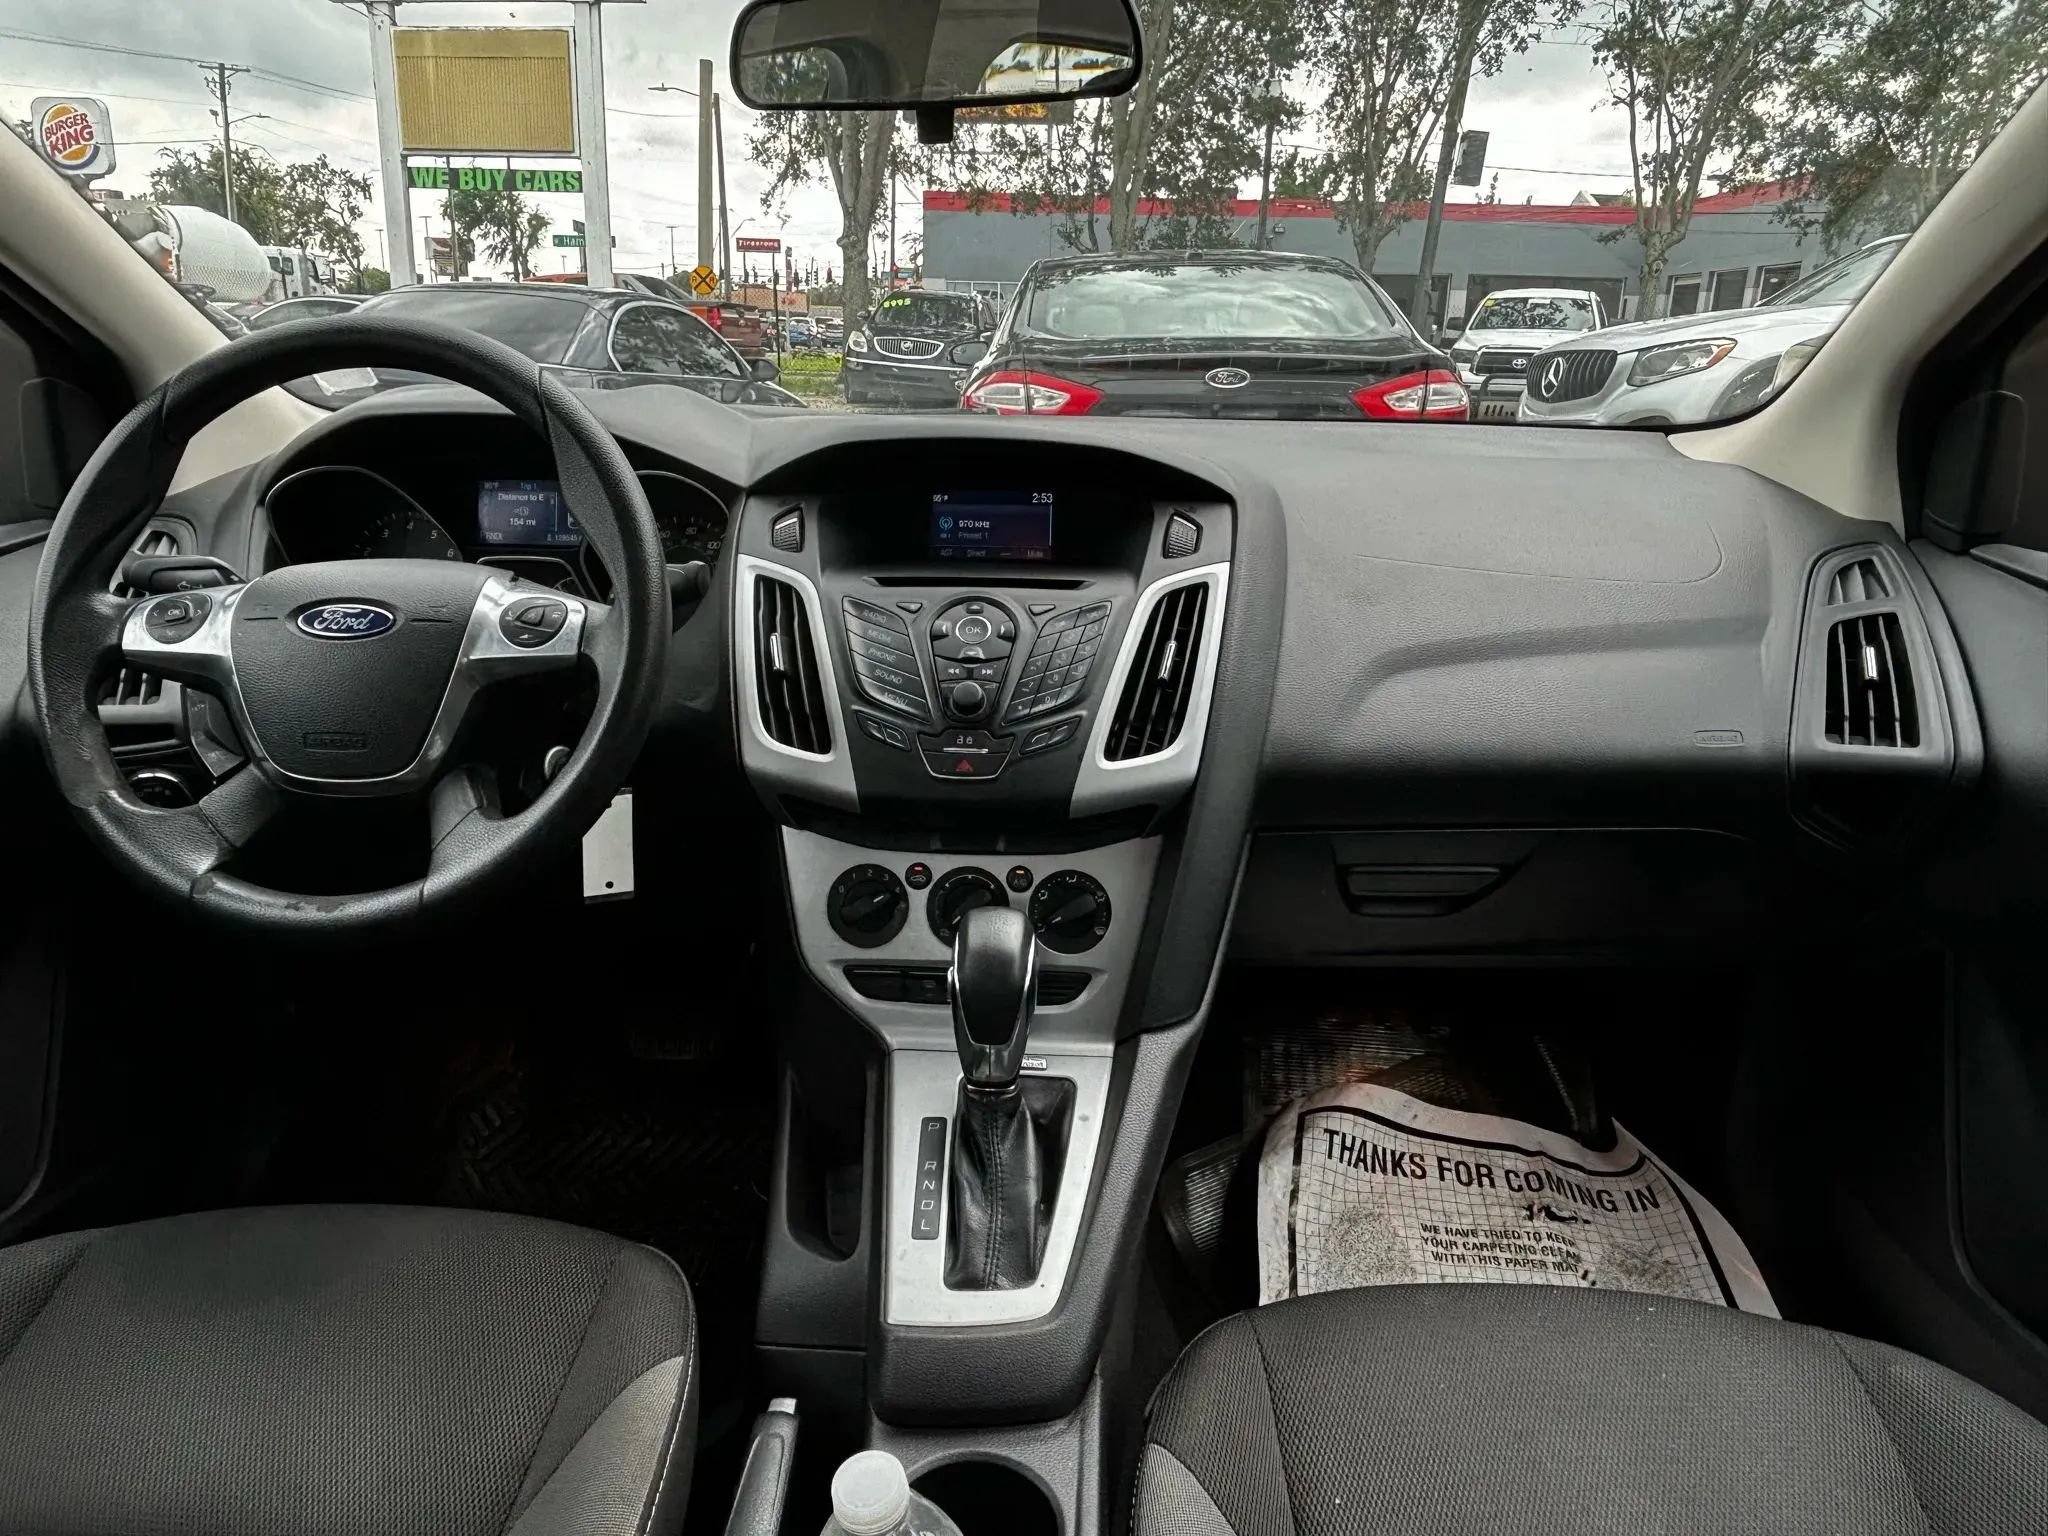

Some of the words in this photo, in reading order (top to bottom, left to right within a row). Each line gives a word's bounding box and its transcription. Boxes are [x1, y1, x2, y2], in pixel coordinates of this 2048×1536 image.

[44, 112, 89, 141] BURGER
[49, 124, 94, 160] KING
[411, 167, 449, 188] WE
[458, 168, 508, 190] BUY
[515, 170, 580, 192] CARS
[498, 492, 528, 501] Distance
[530, 492, 538, 501] to
[539, 493, 545, 501] E
[1032, 492, 1053, 503] 2:53
[510, 517, 524, 526] 154
[526, 517, 536, 526] mi
[958, 520, 973, 528] 970
[974, 519, 990, 528] kHz
[313, 607, 375, 631] Ford
[863, 609, 887, 624] RADIO
[965, 626, 981, 634] OK
[868, 647, 897, 662] PHONE
[874, 668, 902, 684] SOUND
[884, 691, 907, 706] MENU
[928, 1122, 940, 1131] P
[924, 1161, 937, 1171] R
[1323, 1128, 1427, 1180] THANKS
[1436, 1156, 1496, 1189] FOR
[1504, 1168, 1619, 1213] COMING
[1624, 1185, 1660, 1213] IN
[922, 1180, 935, 1190] N
[920, 1200, 934, 1210] D
[920, 1219, 930, 1230] L
[1420, 1222, 1441, 1235] WE
[1445, 1226, 1478, 1239] HAVE
[1483, 1229, 1521, 1241] TRIED
[1524, 1230, 1542, 1242] TO
[1545, 1231, 1576, 1248] KEEP
[1421, 1235, 1458, 1251] YOUR
[1462, 1240, 1538, 1256] CARPETING
[1540, 1245, 1581, 1261] CLEAN
[1430, 1250, 1467, 1265] WITH
[1469, 1254, 1501, 1267] THIS
[1504, 1257, 1548, 1270] PAPER
[1552, 1261, 1580, 1274] MAT
